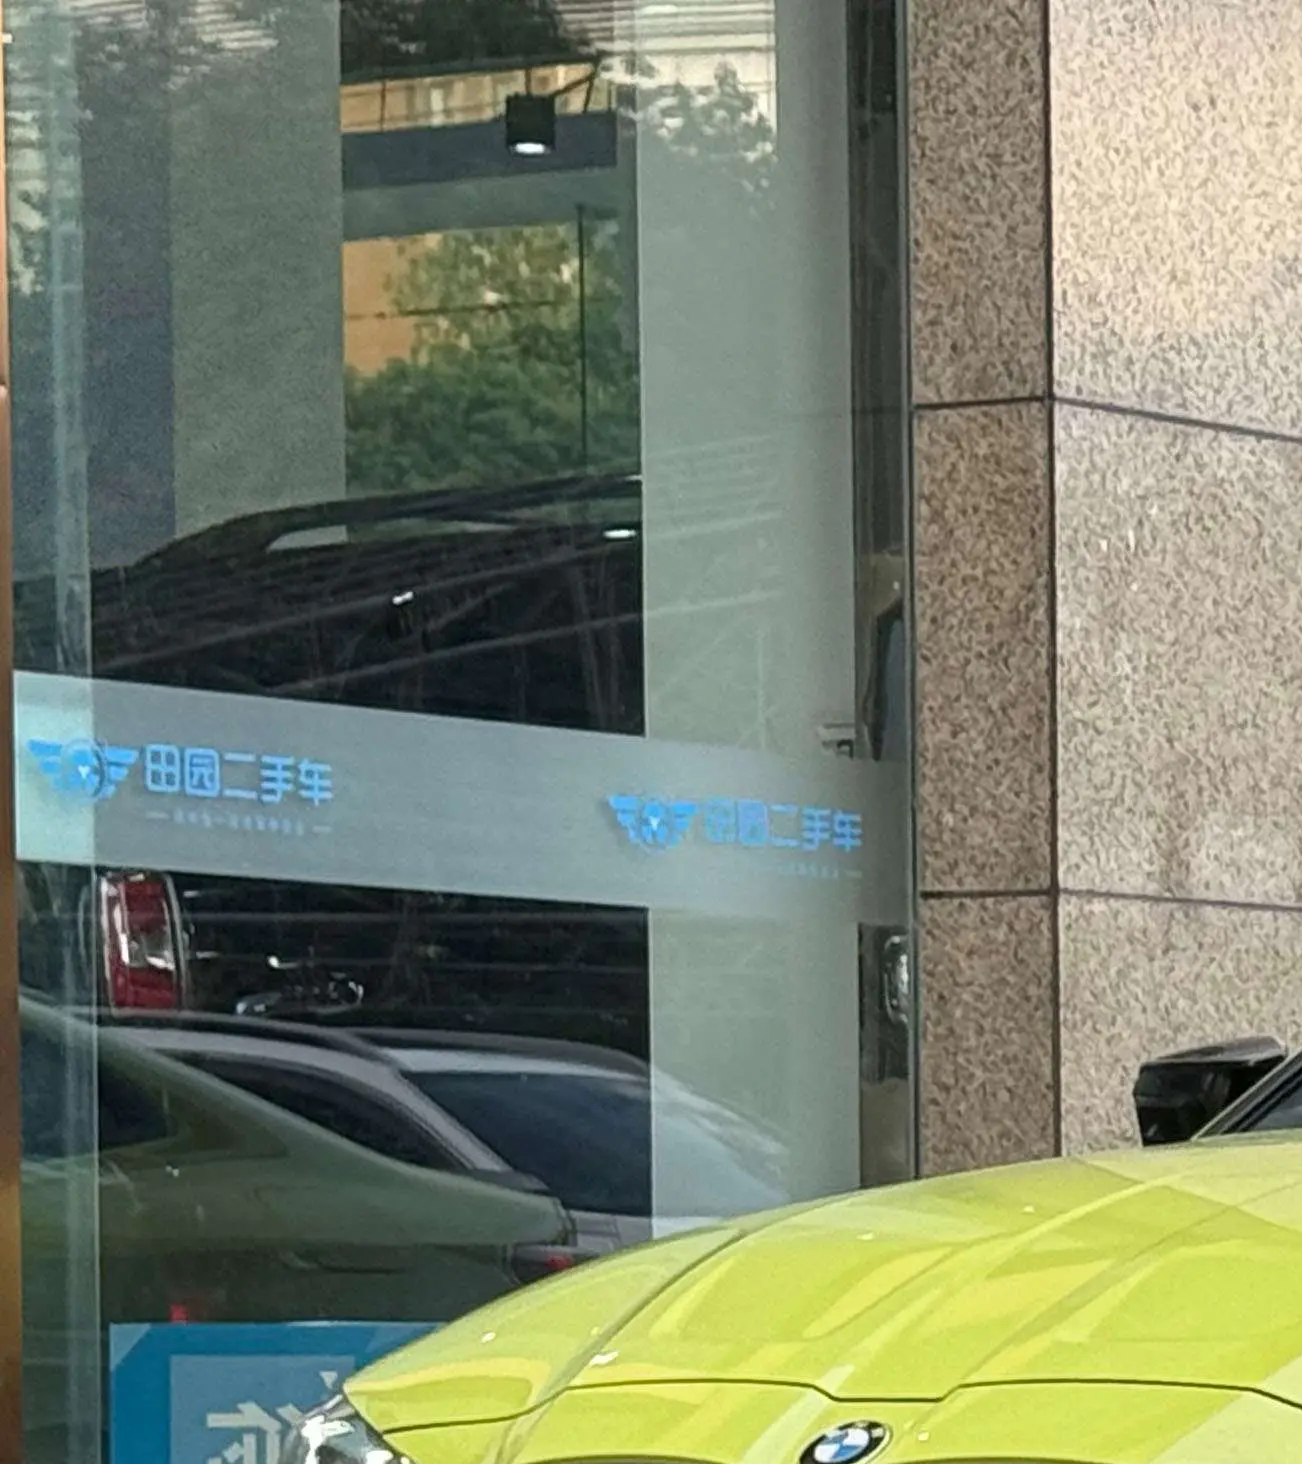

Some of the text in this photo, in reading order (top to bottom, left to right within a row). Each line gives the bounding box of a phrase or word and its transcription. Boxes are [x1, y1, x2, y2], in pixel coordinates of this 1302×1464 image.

[145, 743, 333, 806] 田园二手车
